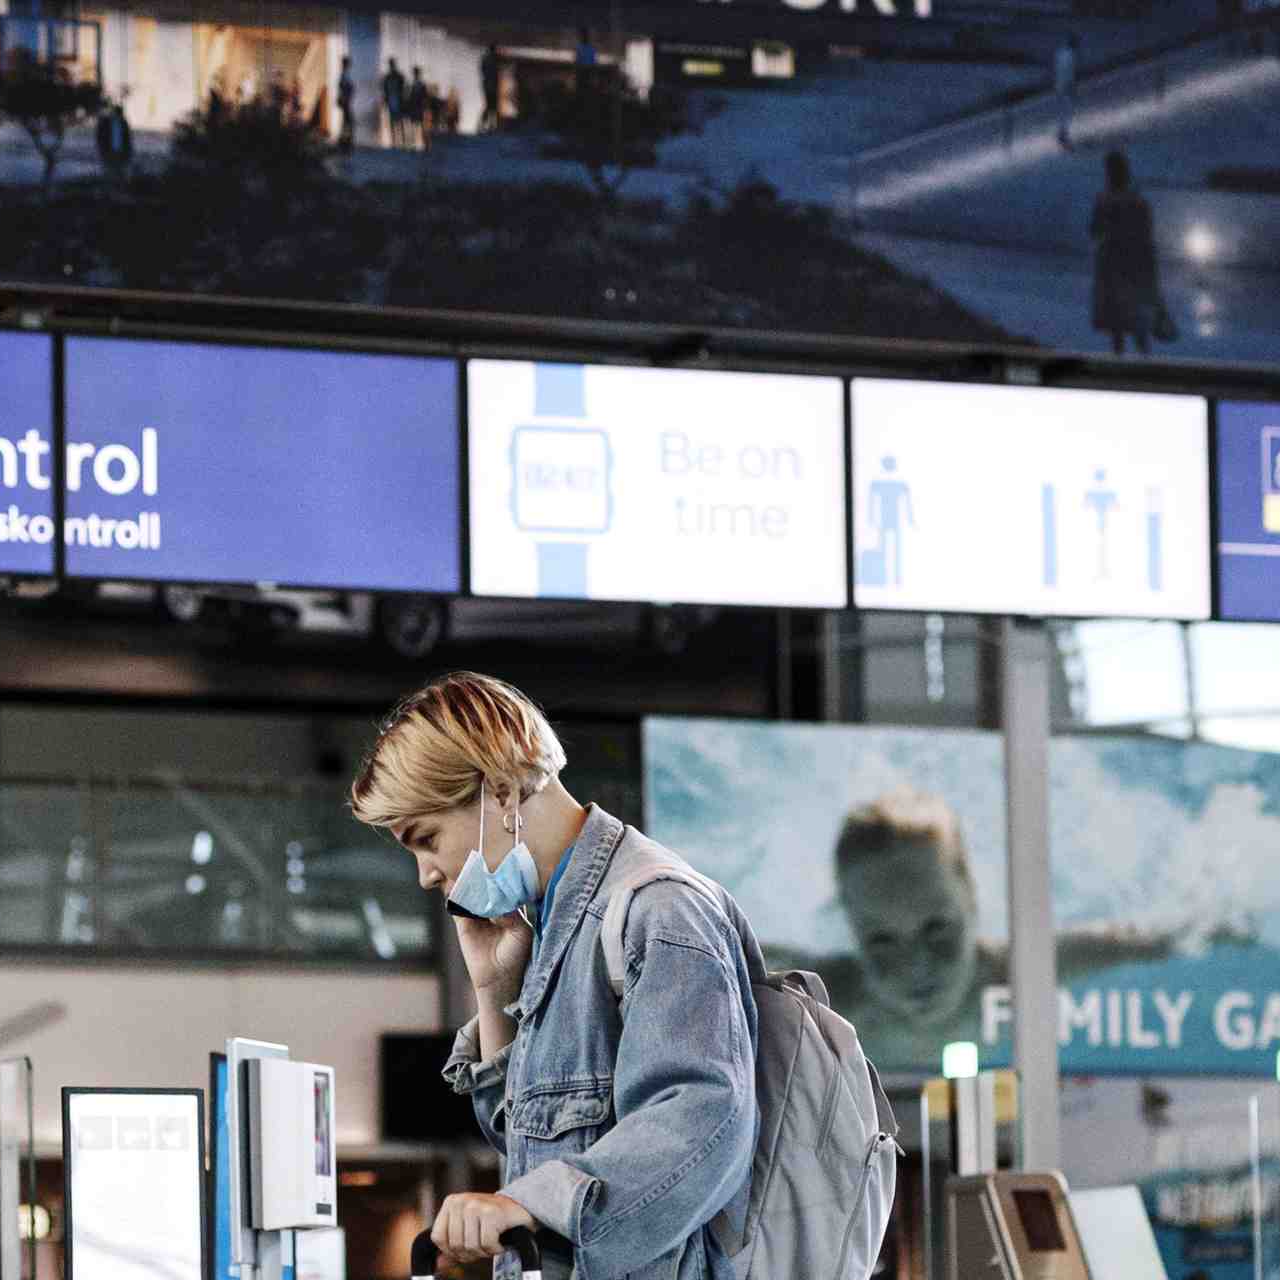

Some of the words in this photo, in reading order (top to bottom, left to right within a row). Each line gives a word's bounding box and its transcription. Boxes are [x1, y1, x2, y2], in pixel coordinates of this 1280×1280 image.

[657, 431, 725, 477] Be
[736, 445, 804, 481] on
[980, 986, 1193, 1050] FMILY
